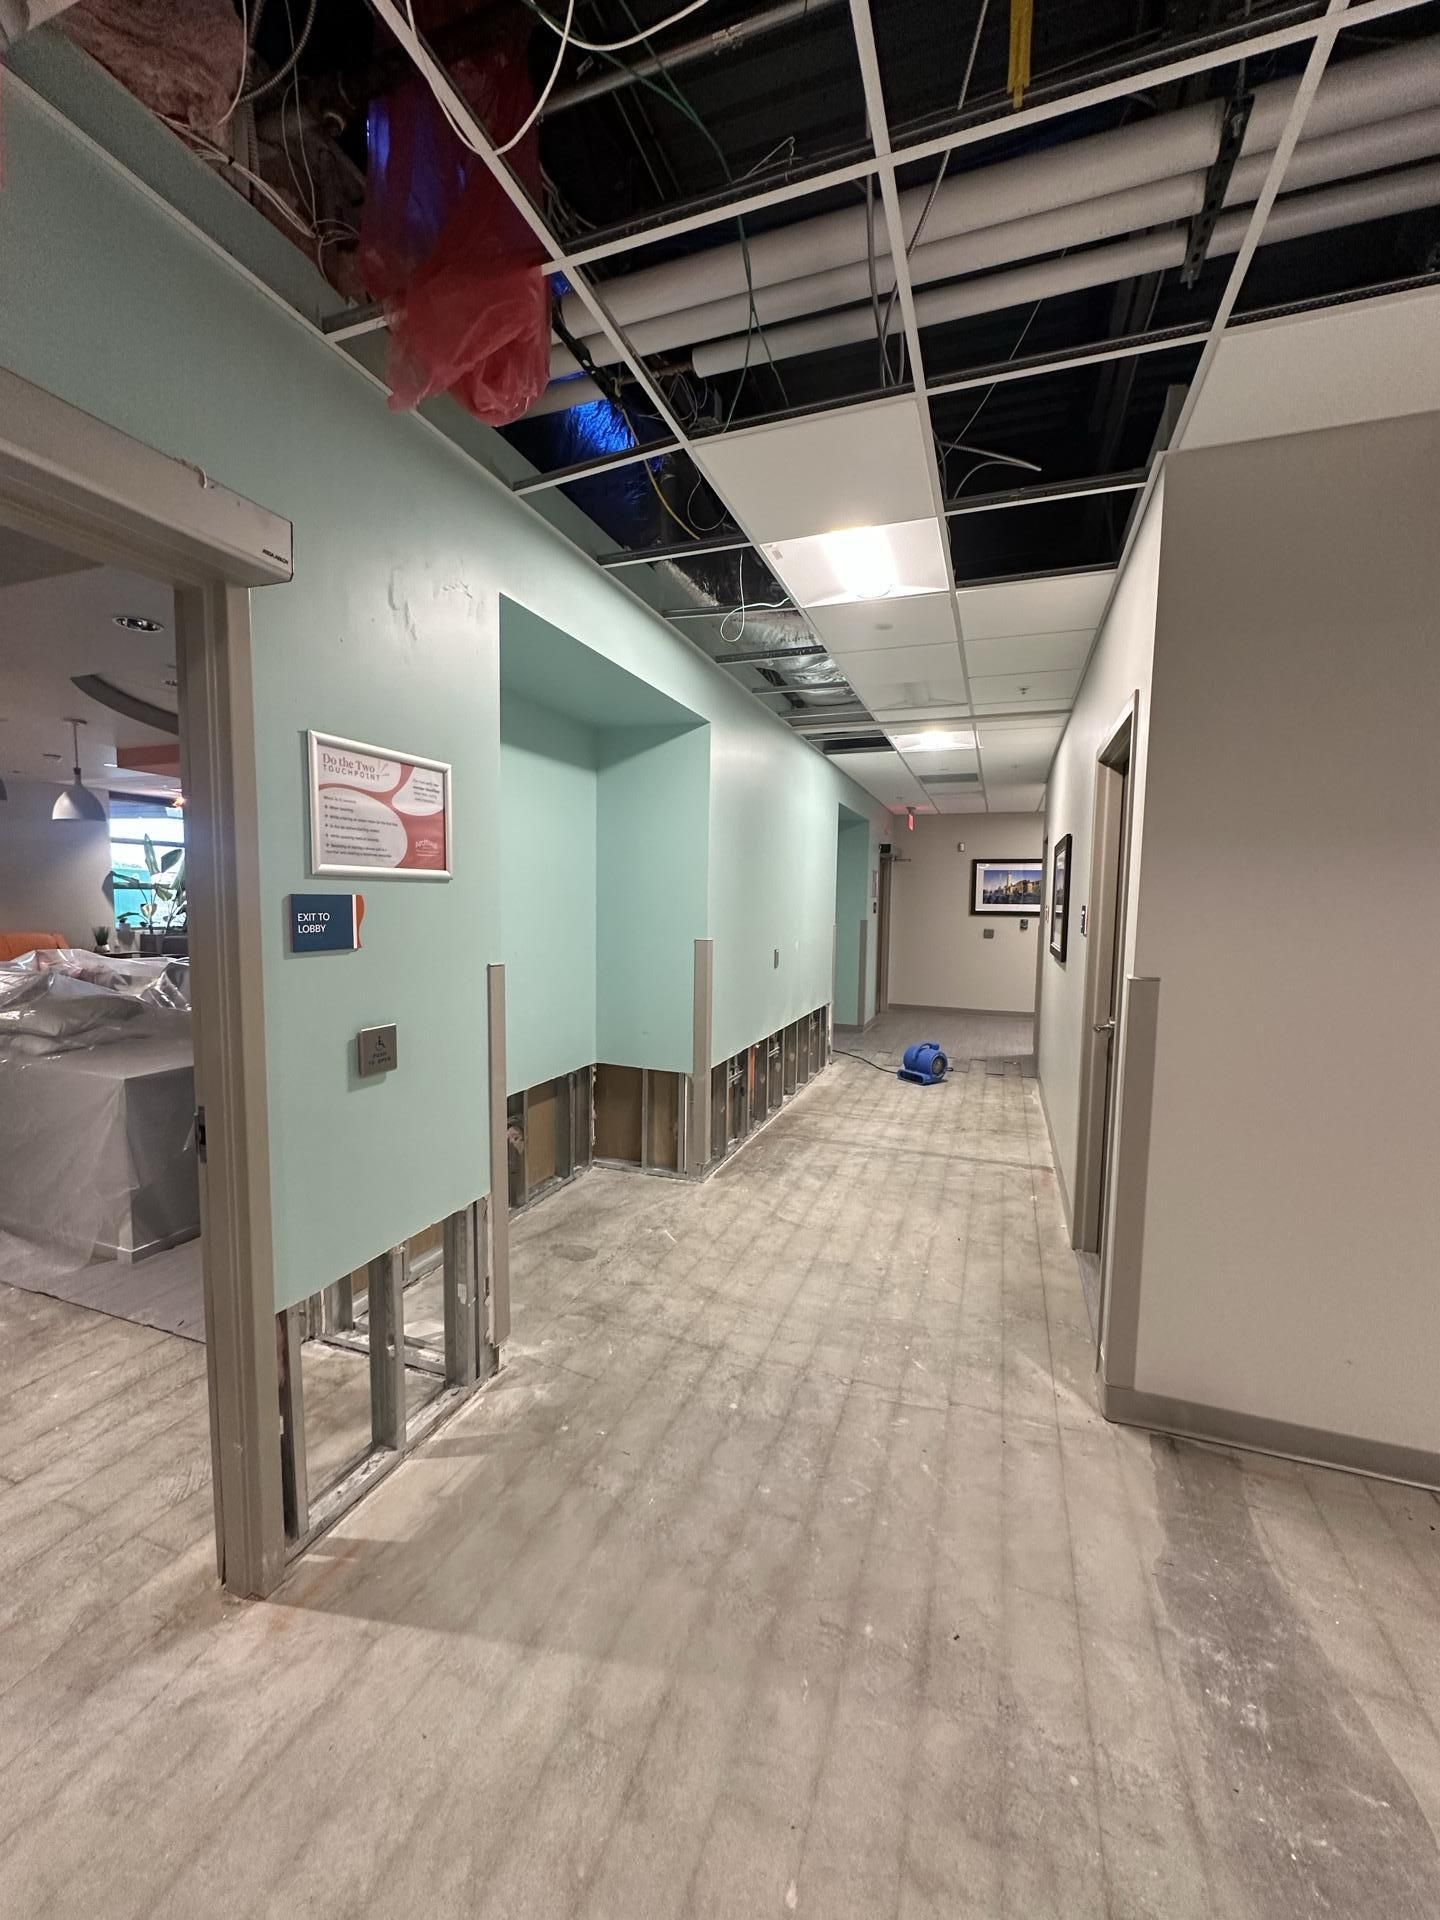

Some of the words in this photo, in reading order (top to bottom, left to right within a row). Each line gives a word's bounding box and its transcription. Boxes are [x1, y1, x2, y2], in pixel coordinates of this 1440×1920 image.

[322, 753, 337, 765] Do
[339, 756, 354, 769] the
[355, 760, 375, 773] Two
[322, 764, 380, 781] TOUCHPOINT
[297, 913, 316, 921] EXIT
[318, 912, 330, 921] TO
[298, 924, 326, 933] LOBBY
